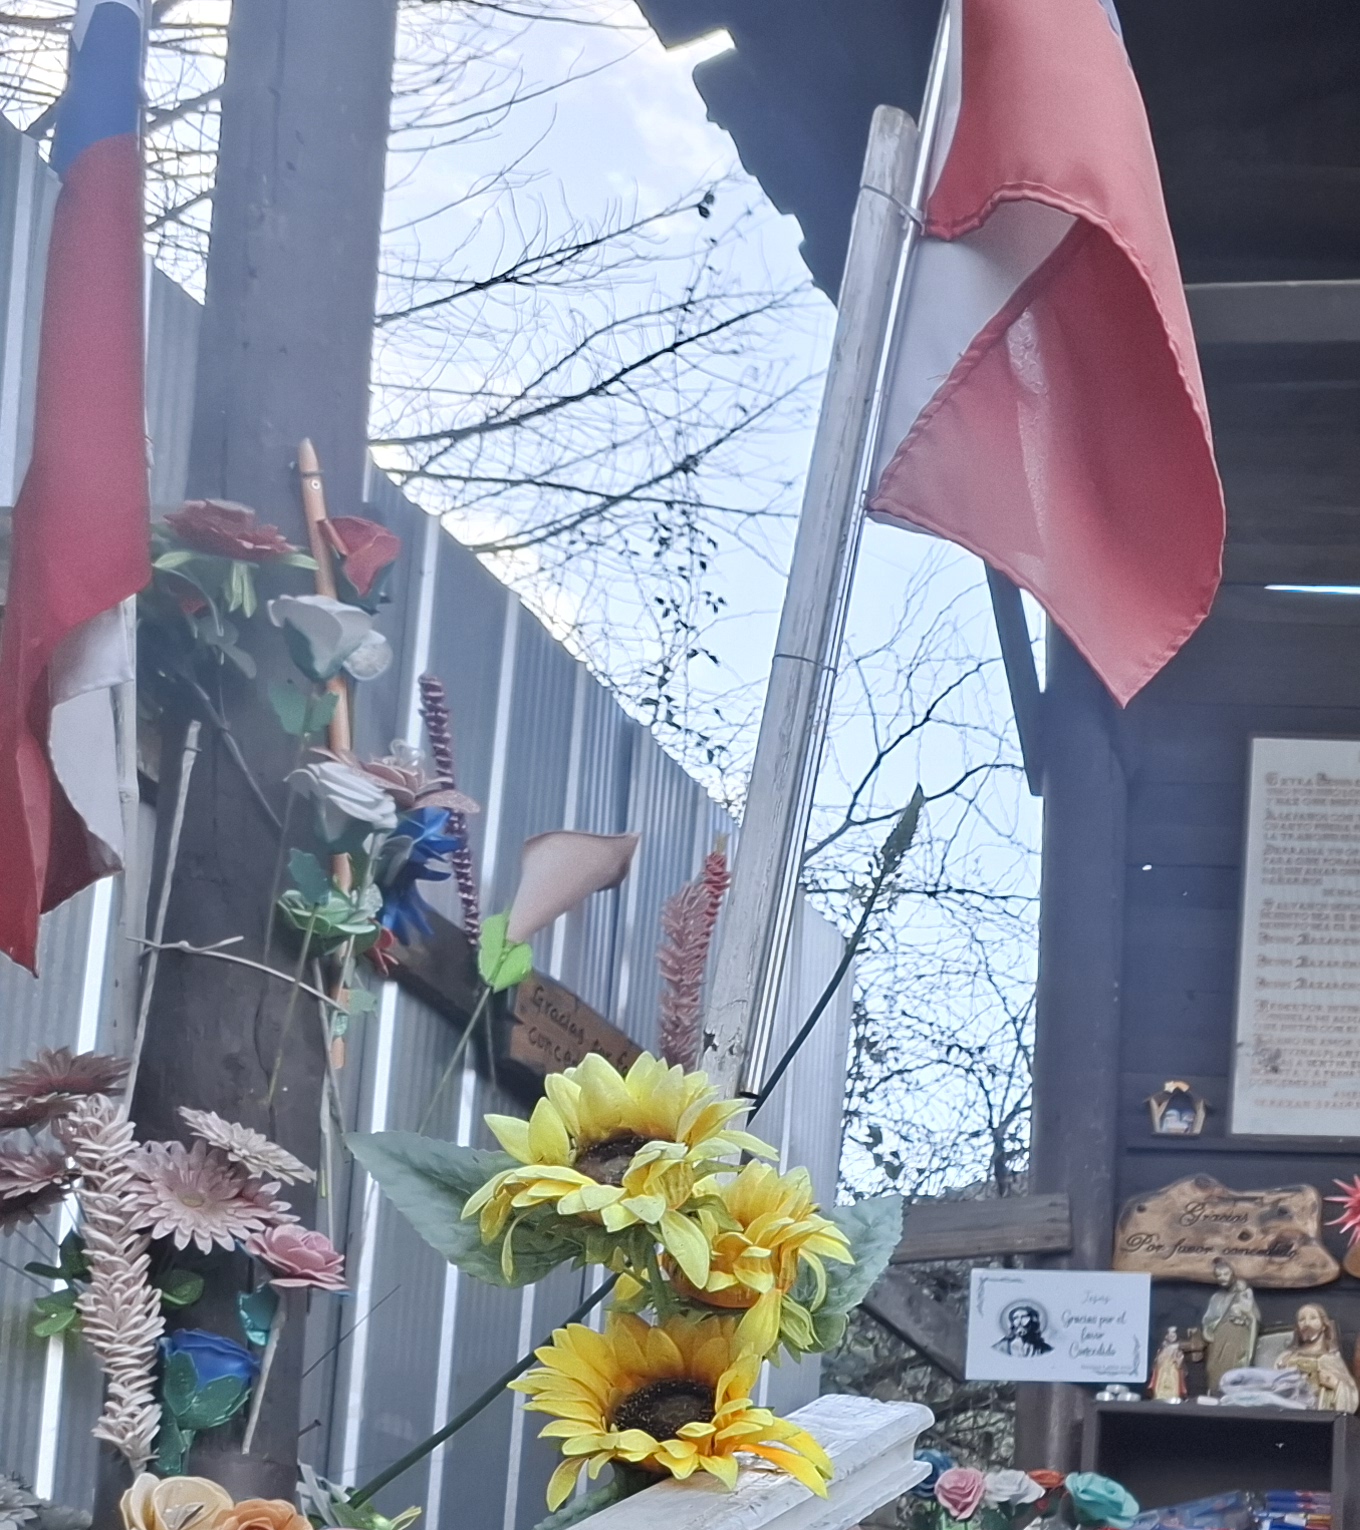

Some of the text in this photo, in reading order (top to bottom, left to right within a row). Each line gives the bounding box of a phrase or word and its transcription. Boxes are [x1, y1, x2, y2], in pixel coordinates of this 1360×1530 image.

[1179, 1202, 1249, 1226] Gracias
[1124, 1233, 1298, 1260] Por favor concedido
[1061, 1310, 1097, 1328] Gracias
